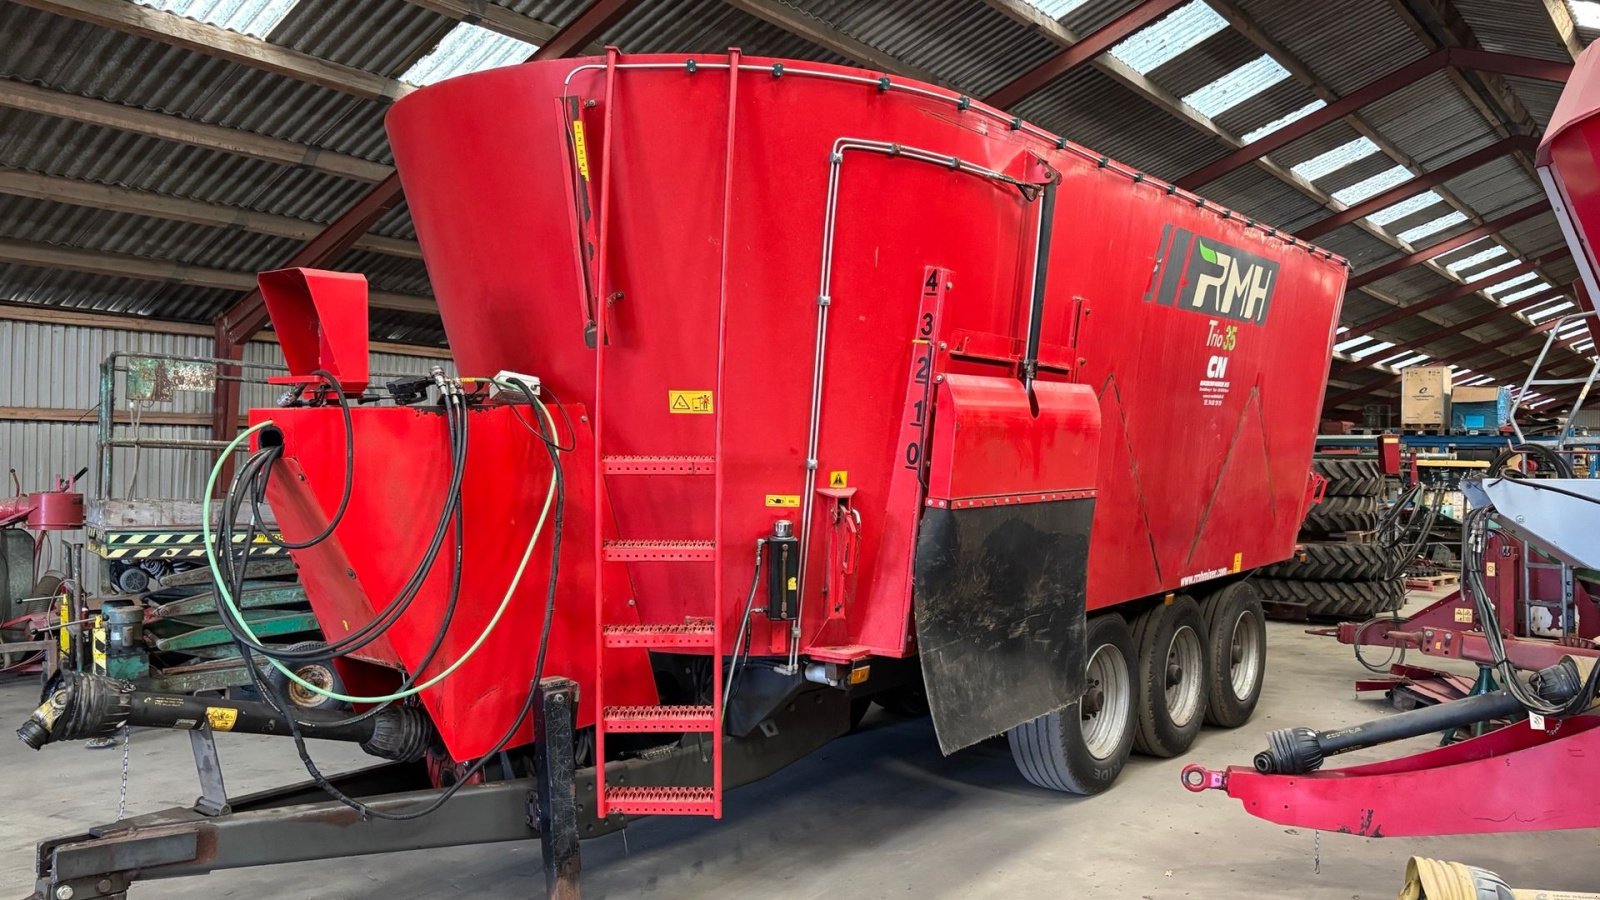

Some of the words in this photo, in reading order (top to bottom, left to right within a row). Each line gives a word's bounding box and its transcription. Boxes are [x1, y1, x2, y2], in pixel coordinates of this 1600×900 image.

[925, 269, 937, 291] 4
[1192, 243, 1272, 321] RMH
[921, 313, 933, 335] 3
[1206, 320, 1223, 347] Trio
[1223, 325, 1237, 351] 35
[916, 357, 929, 379] 2
[1207, 356, 1228, 378] CN
[914, 401, 922, 422] 1
[906, 443, 919, 465] 0
